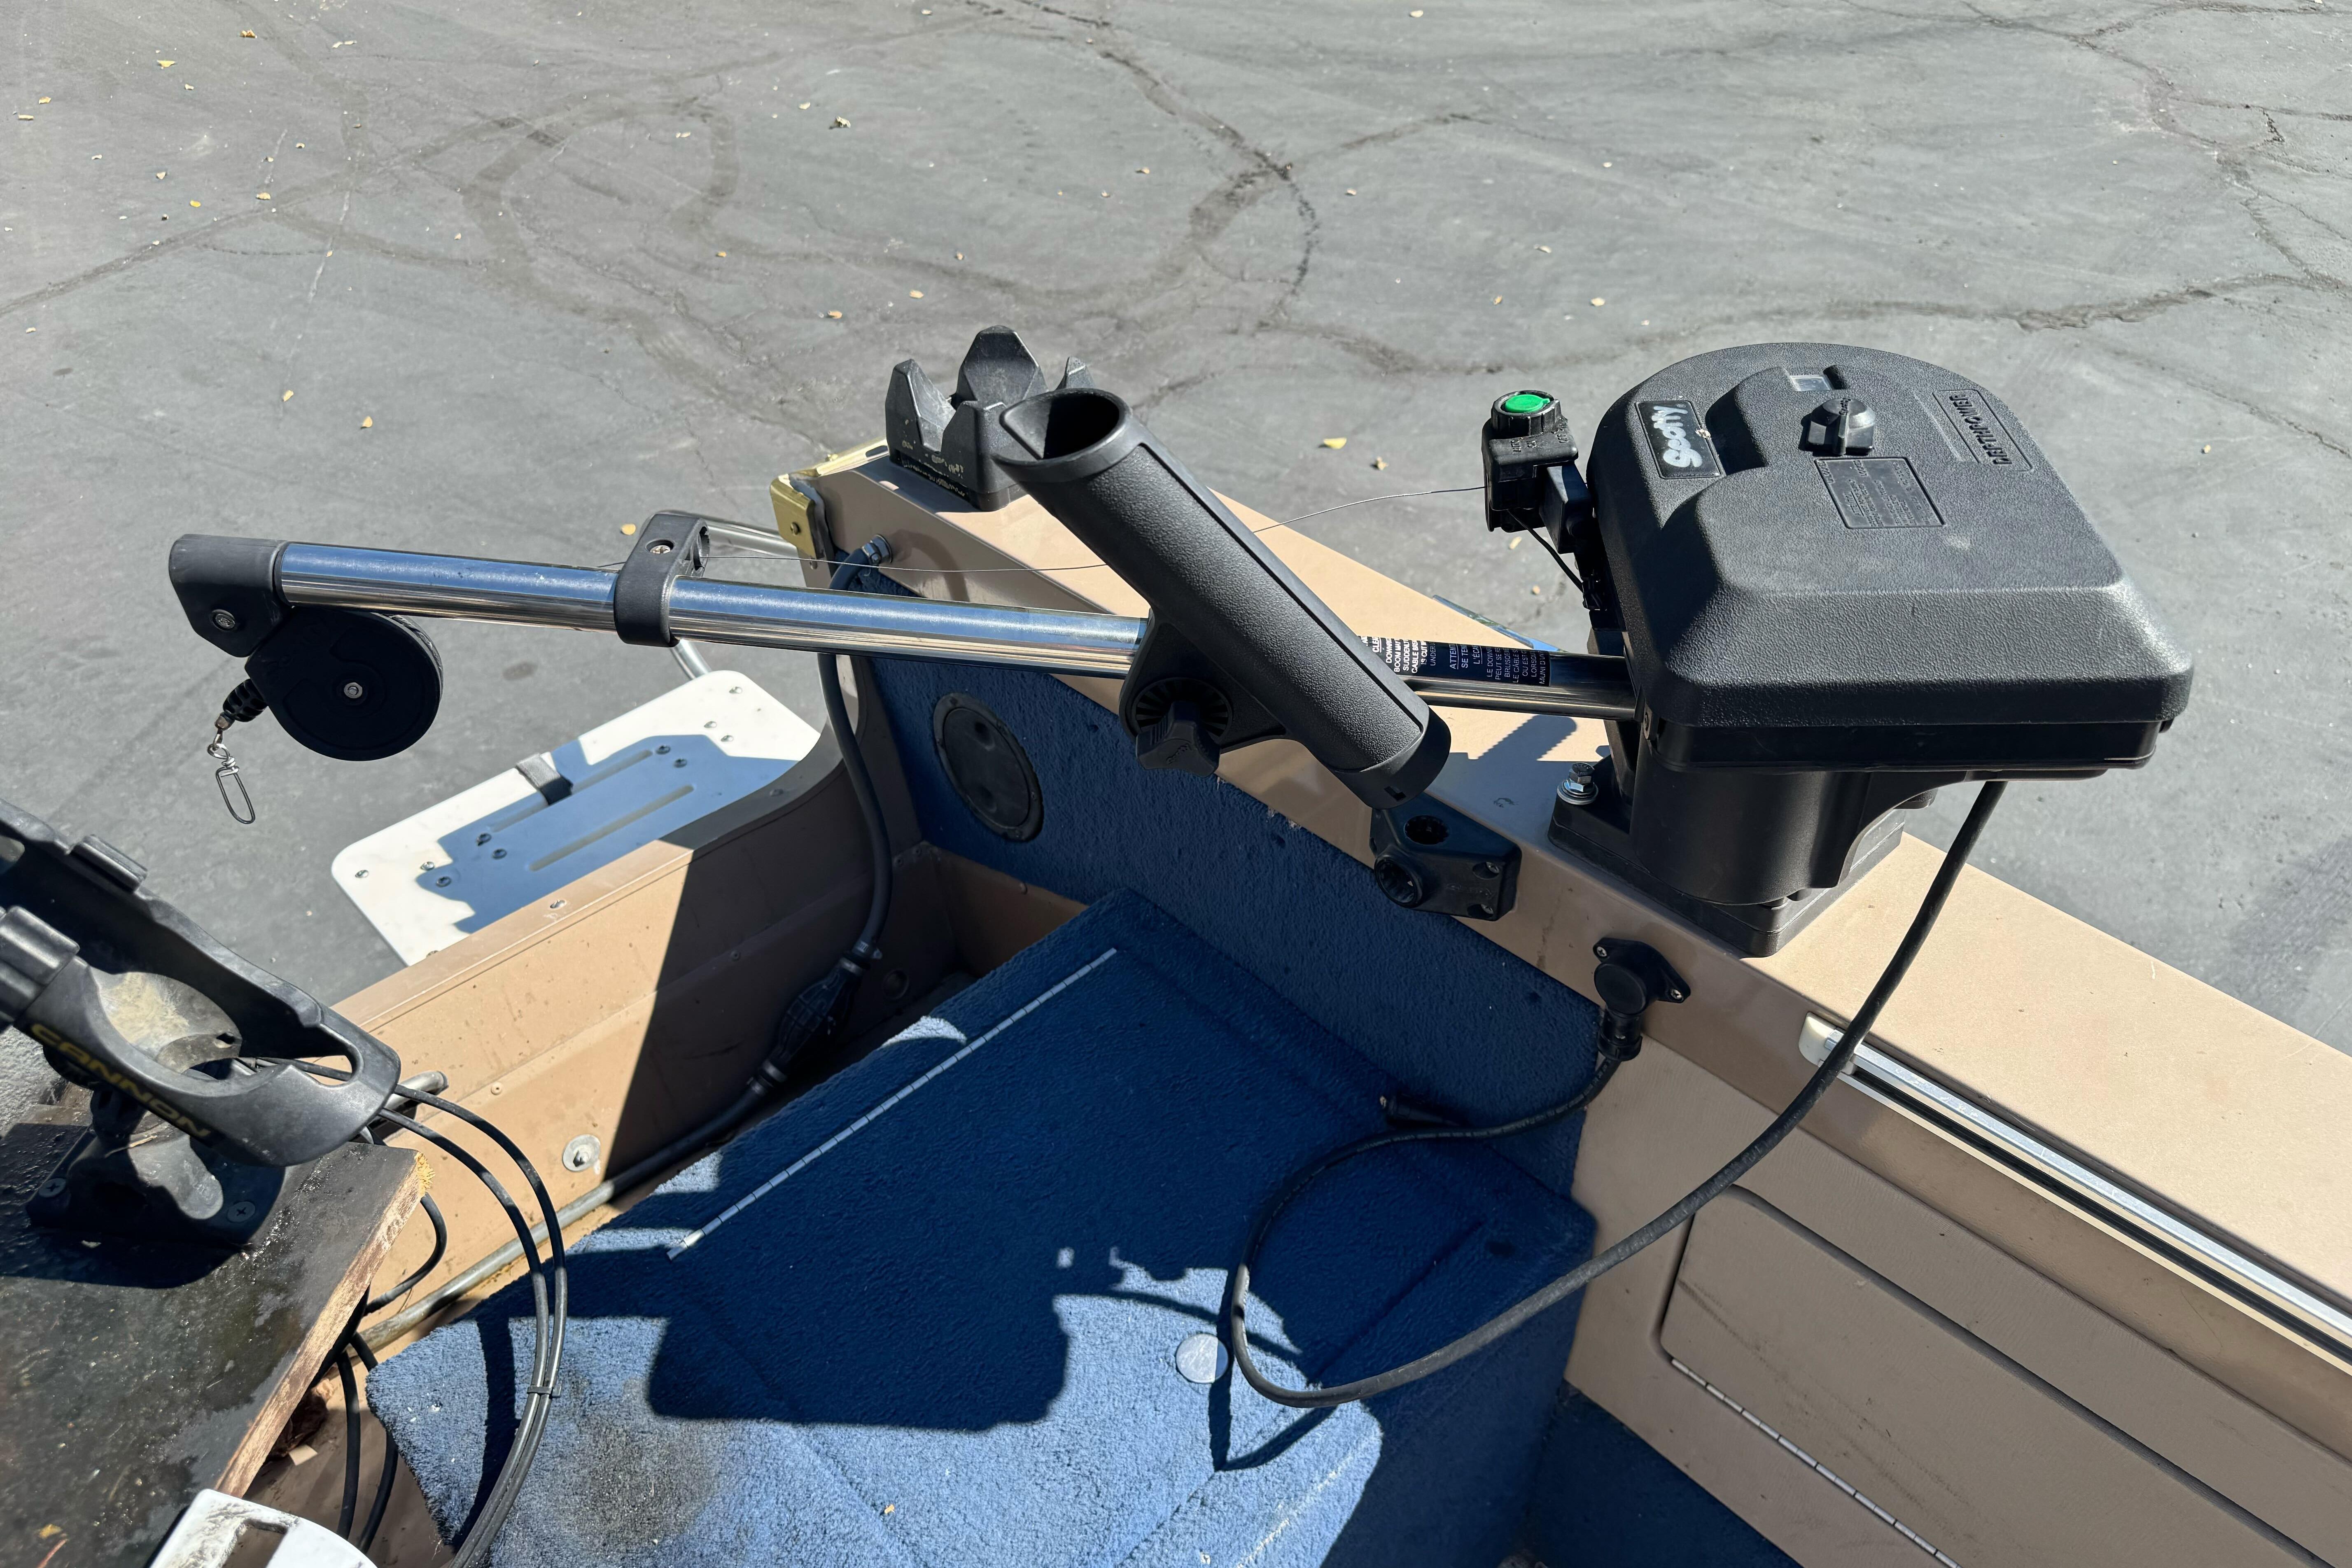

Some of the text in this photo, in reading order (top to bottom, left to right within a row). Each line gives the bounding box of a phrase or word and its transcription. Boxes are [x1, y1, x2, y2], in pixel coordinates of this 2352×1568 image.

[1652, 406, 1702, 467] Scotty
[1949, 395, 2012, 465] DEPTHPOWER
[1461, 658, 1468, 668] SE
[1486, 669, 1493, 677] LE
[1522, 666, 1528, 676] OU
[30, 1023, 211, 1137] CANNON
